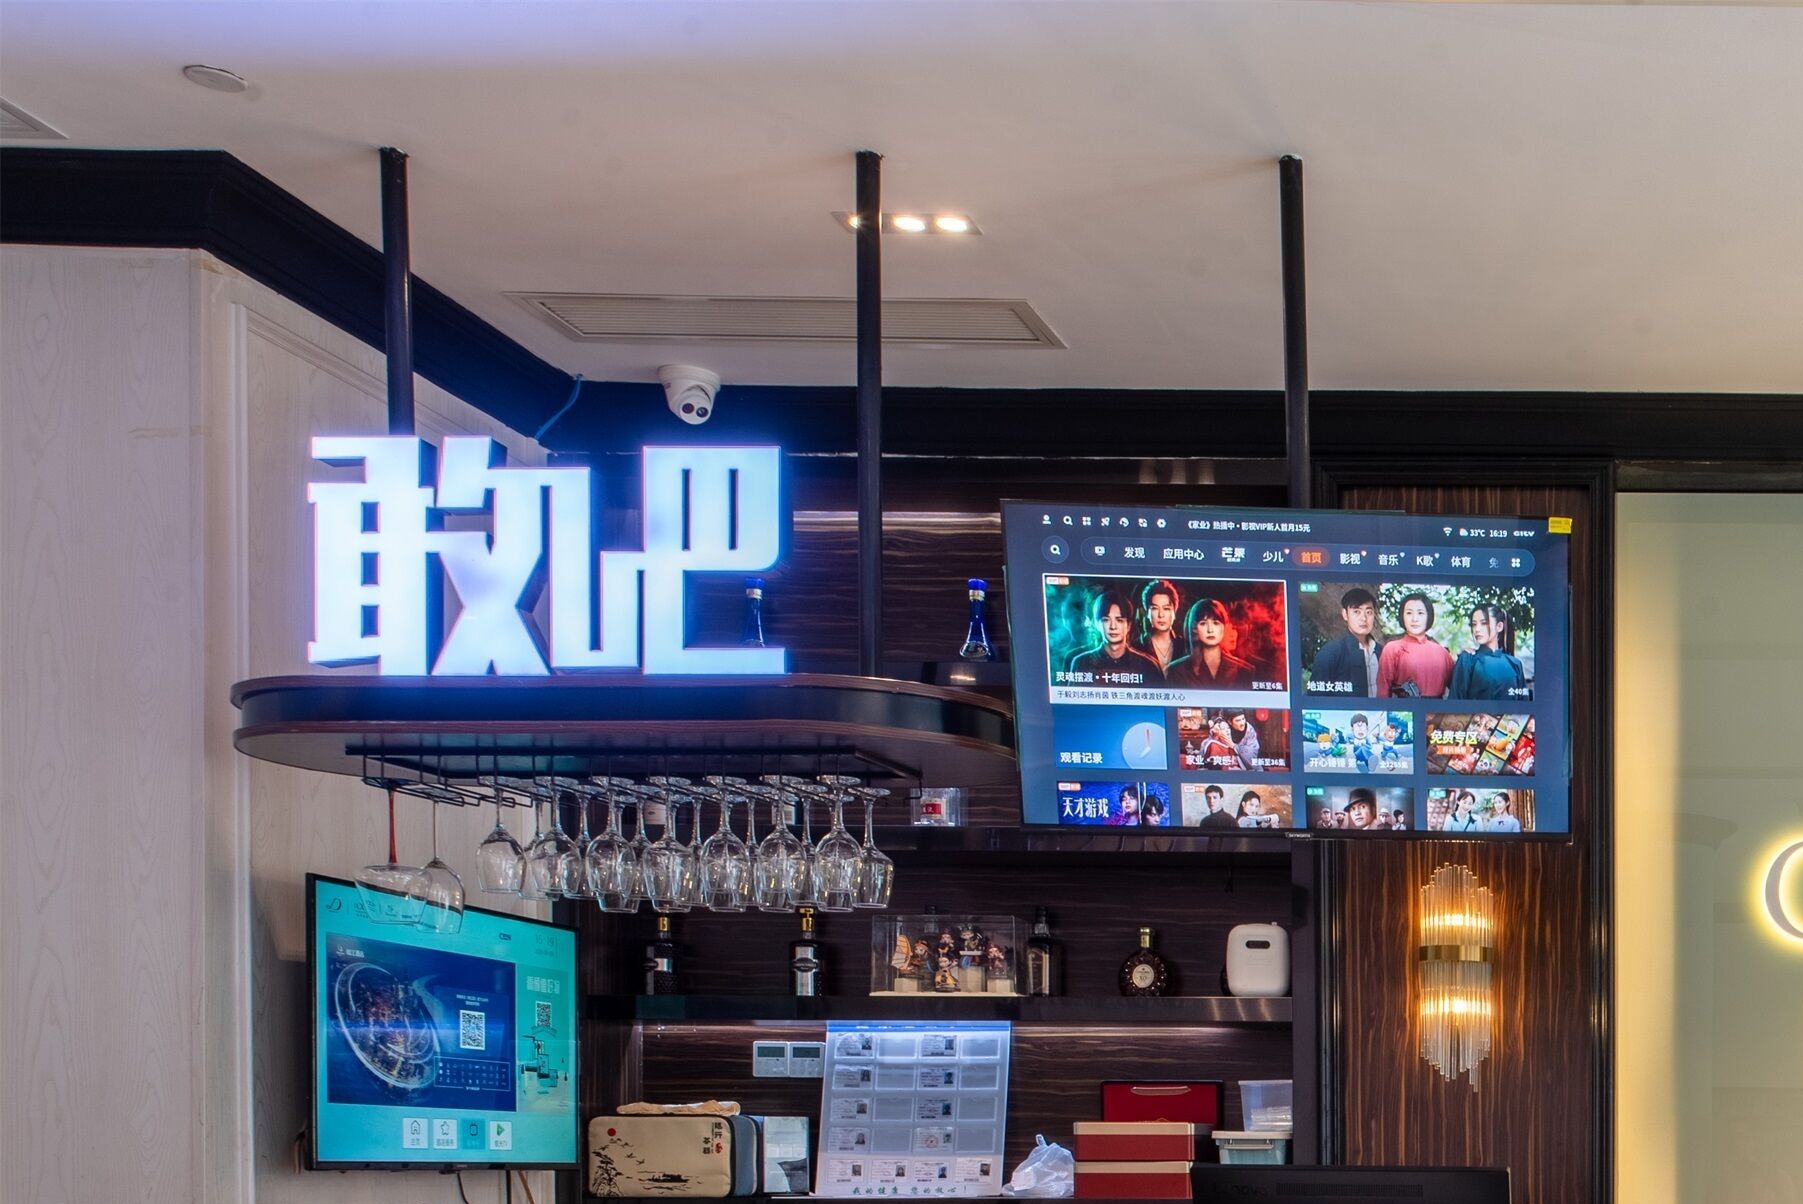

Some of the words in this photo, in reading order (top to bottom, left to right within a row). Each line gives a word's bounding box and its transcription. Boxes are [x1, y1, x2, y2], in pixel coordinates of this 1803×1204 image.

[1489, 529, 1508, 538] 16:19
[308, 436, 786, 676] 敢吧
[1124, 547, 1146, 559] 发现
[1163, 547, 1205, 560] 应用中心
[1221, 547, 1245, 558] 芒果
[1262, 551, 1284, 563] 少儿
[1301, 552, 1322, 564] 首页
[1340, 553, 1361, 565] 影视
[1378, 554, 1399, 566] 音乐
[1416, 555, 1434, 566] K歌
[1451, 556, 1471, 568] 体育
[1306, 680, 1353, 693] 地道女英雄
[1508, 687, 1529, 696] 全40集
[1430, 730, 1478, 745] 免费专区
[1060, 752, 1103, 764] 观看记录
[1062, 796, 1109, 818] 天才游戏
